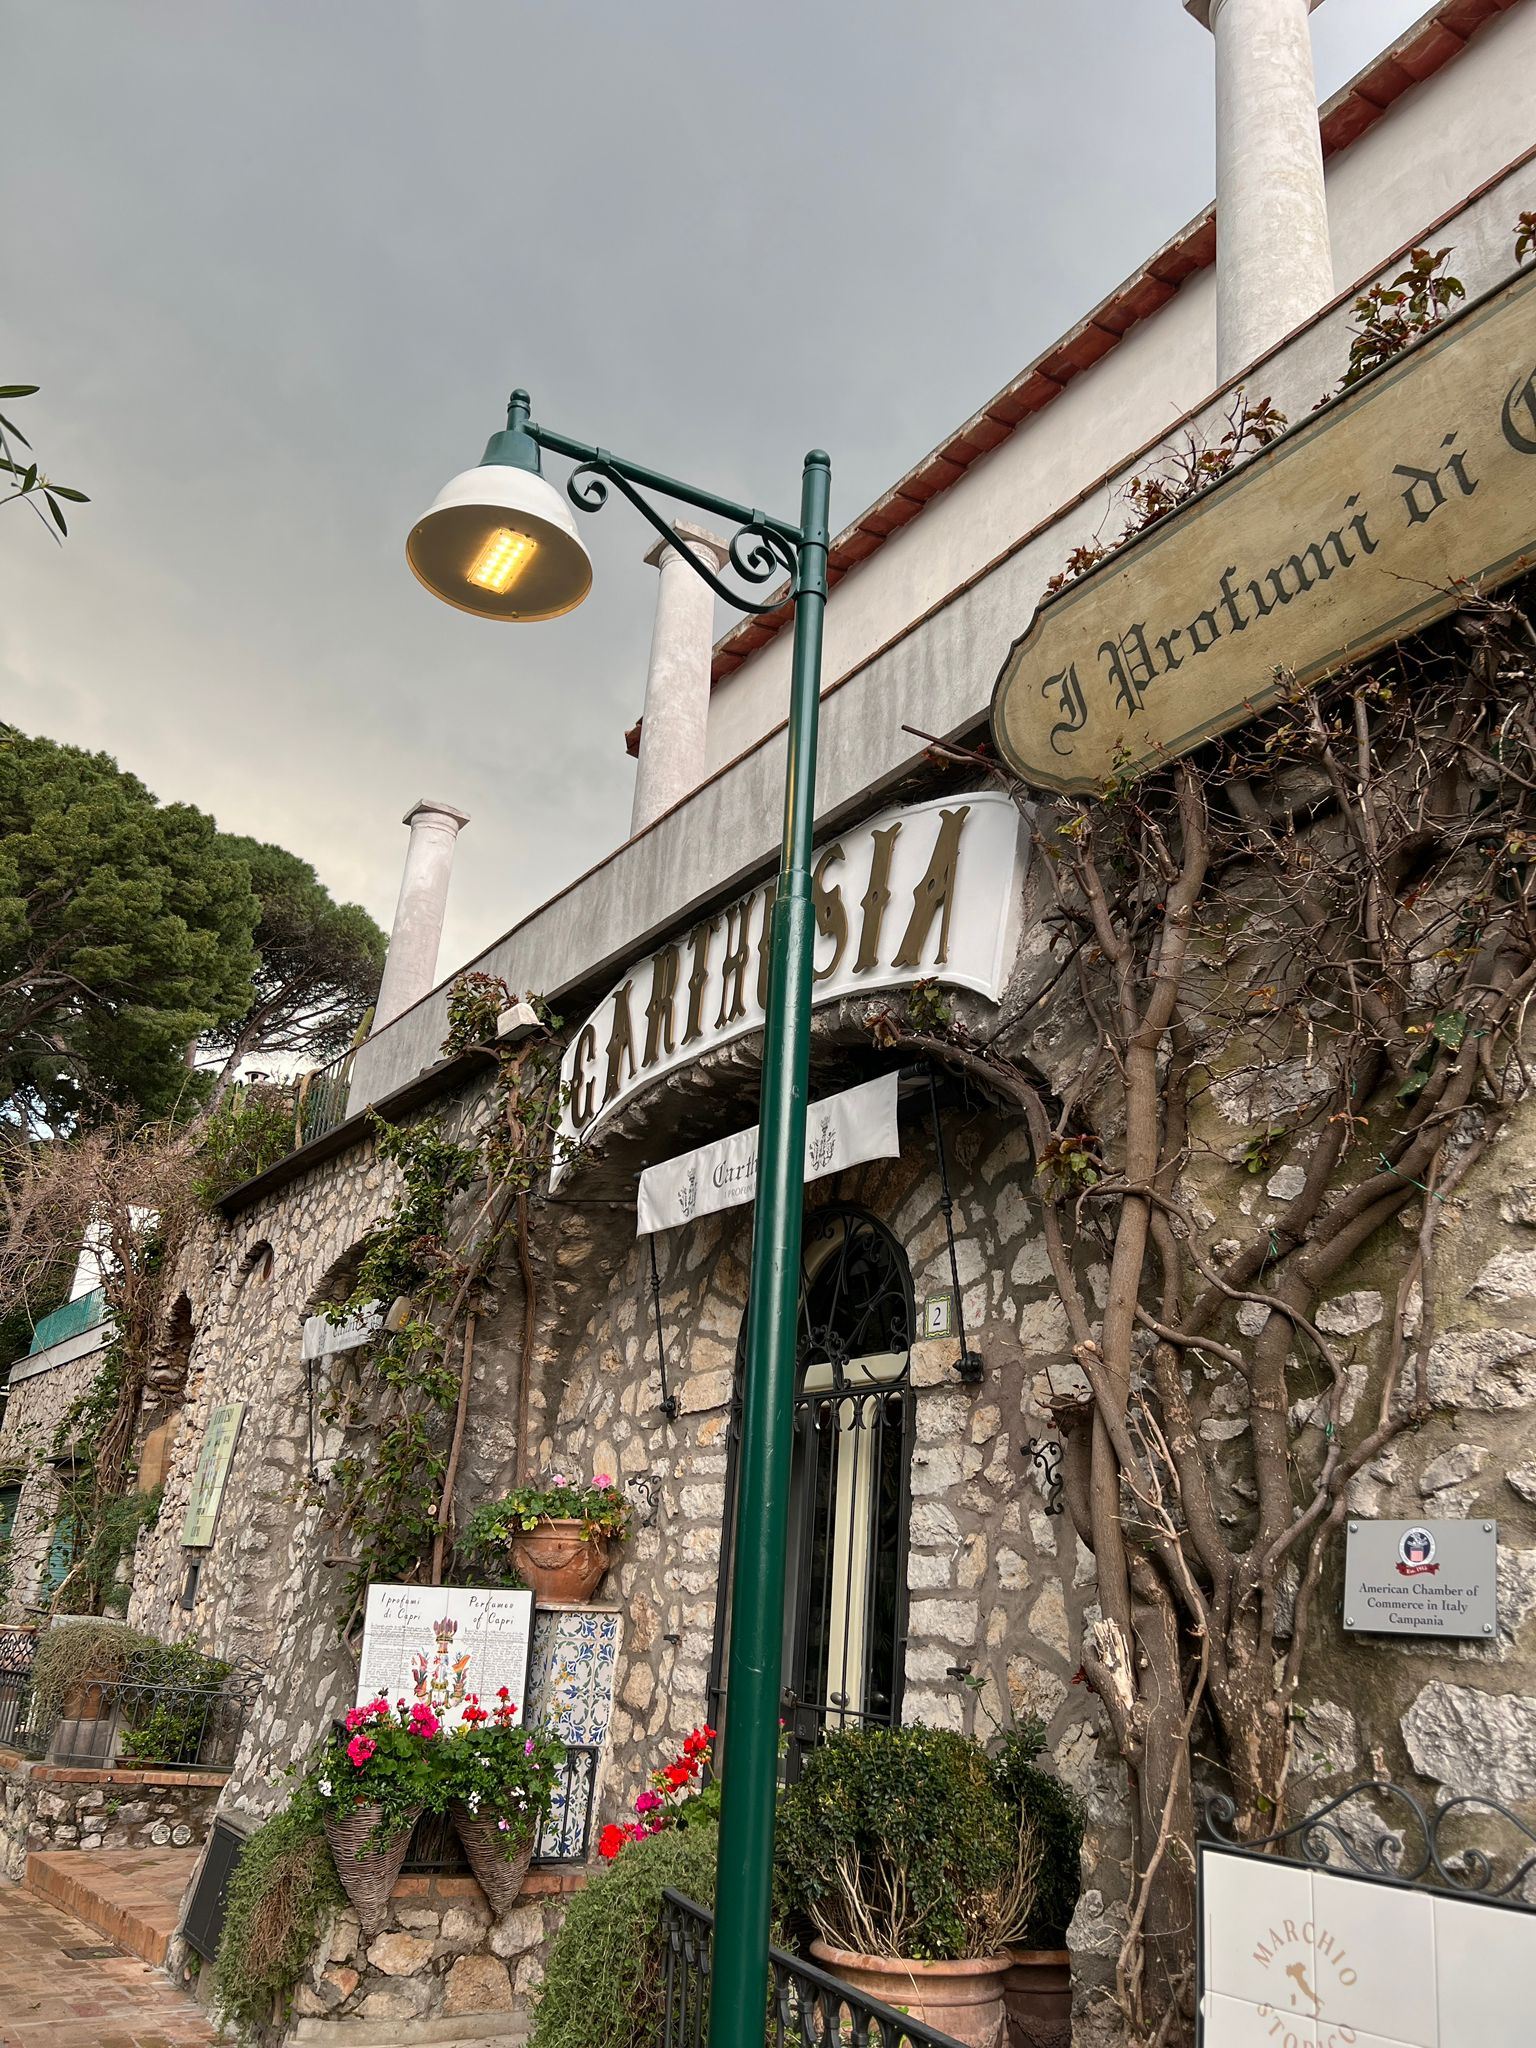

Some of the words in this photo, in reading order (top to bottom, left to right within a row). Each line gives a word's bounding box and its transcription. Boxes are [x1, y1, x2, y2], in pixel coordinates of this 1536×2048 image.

[1042, 661, 1089, 756] I
[1097, 492, 1379, 718] Profumi
[1392, 431, 1480, 527] di
[713, 1151, 758, 1188] Carth
[932, 1306, 942, 1327] 2
[1359, 1583, 1409, 1595] American
[1412, 1584, 1463, 1597] Chamber
[1466, 1585, 1480, 1597] of
[1367, 1597, 1424, 1610] Commerce
[1427, 1600, 1438, 1611] in
[1442, 1600, 1469, 1614] Italy
[383, 1608, 391, 1618] di
[397, 1608, 421, 1625] Capri
[473, 1612, 484, 1630] of
[488, 1612, 514, 1631] Capri
[1388, 1613, 1444, 1628] Campania
[1253, 1919, 1358, 1986] MARCHIO
